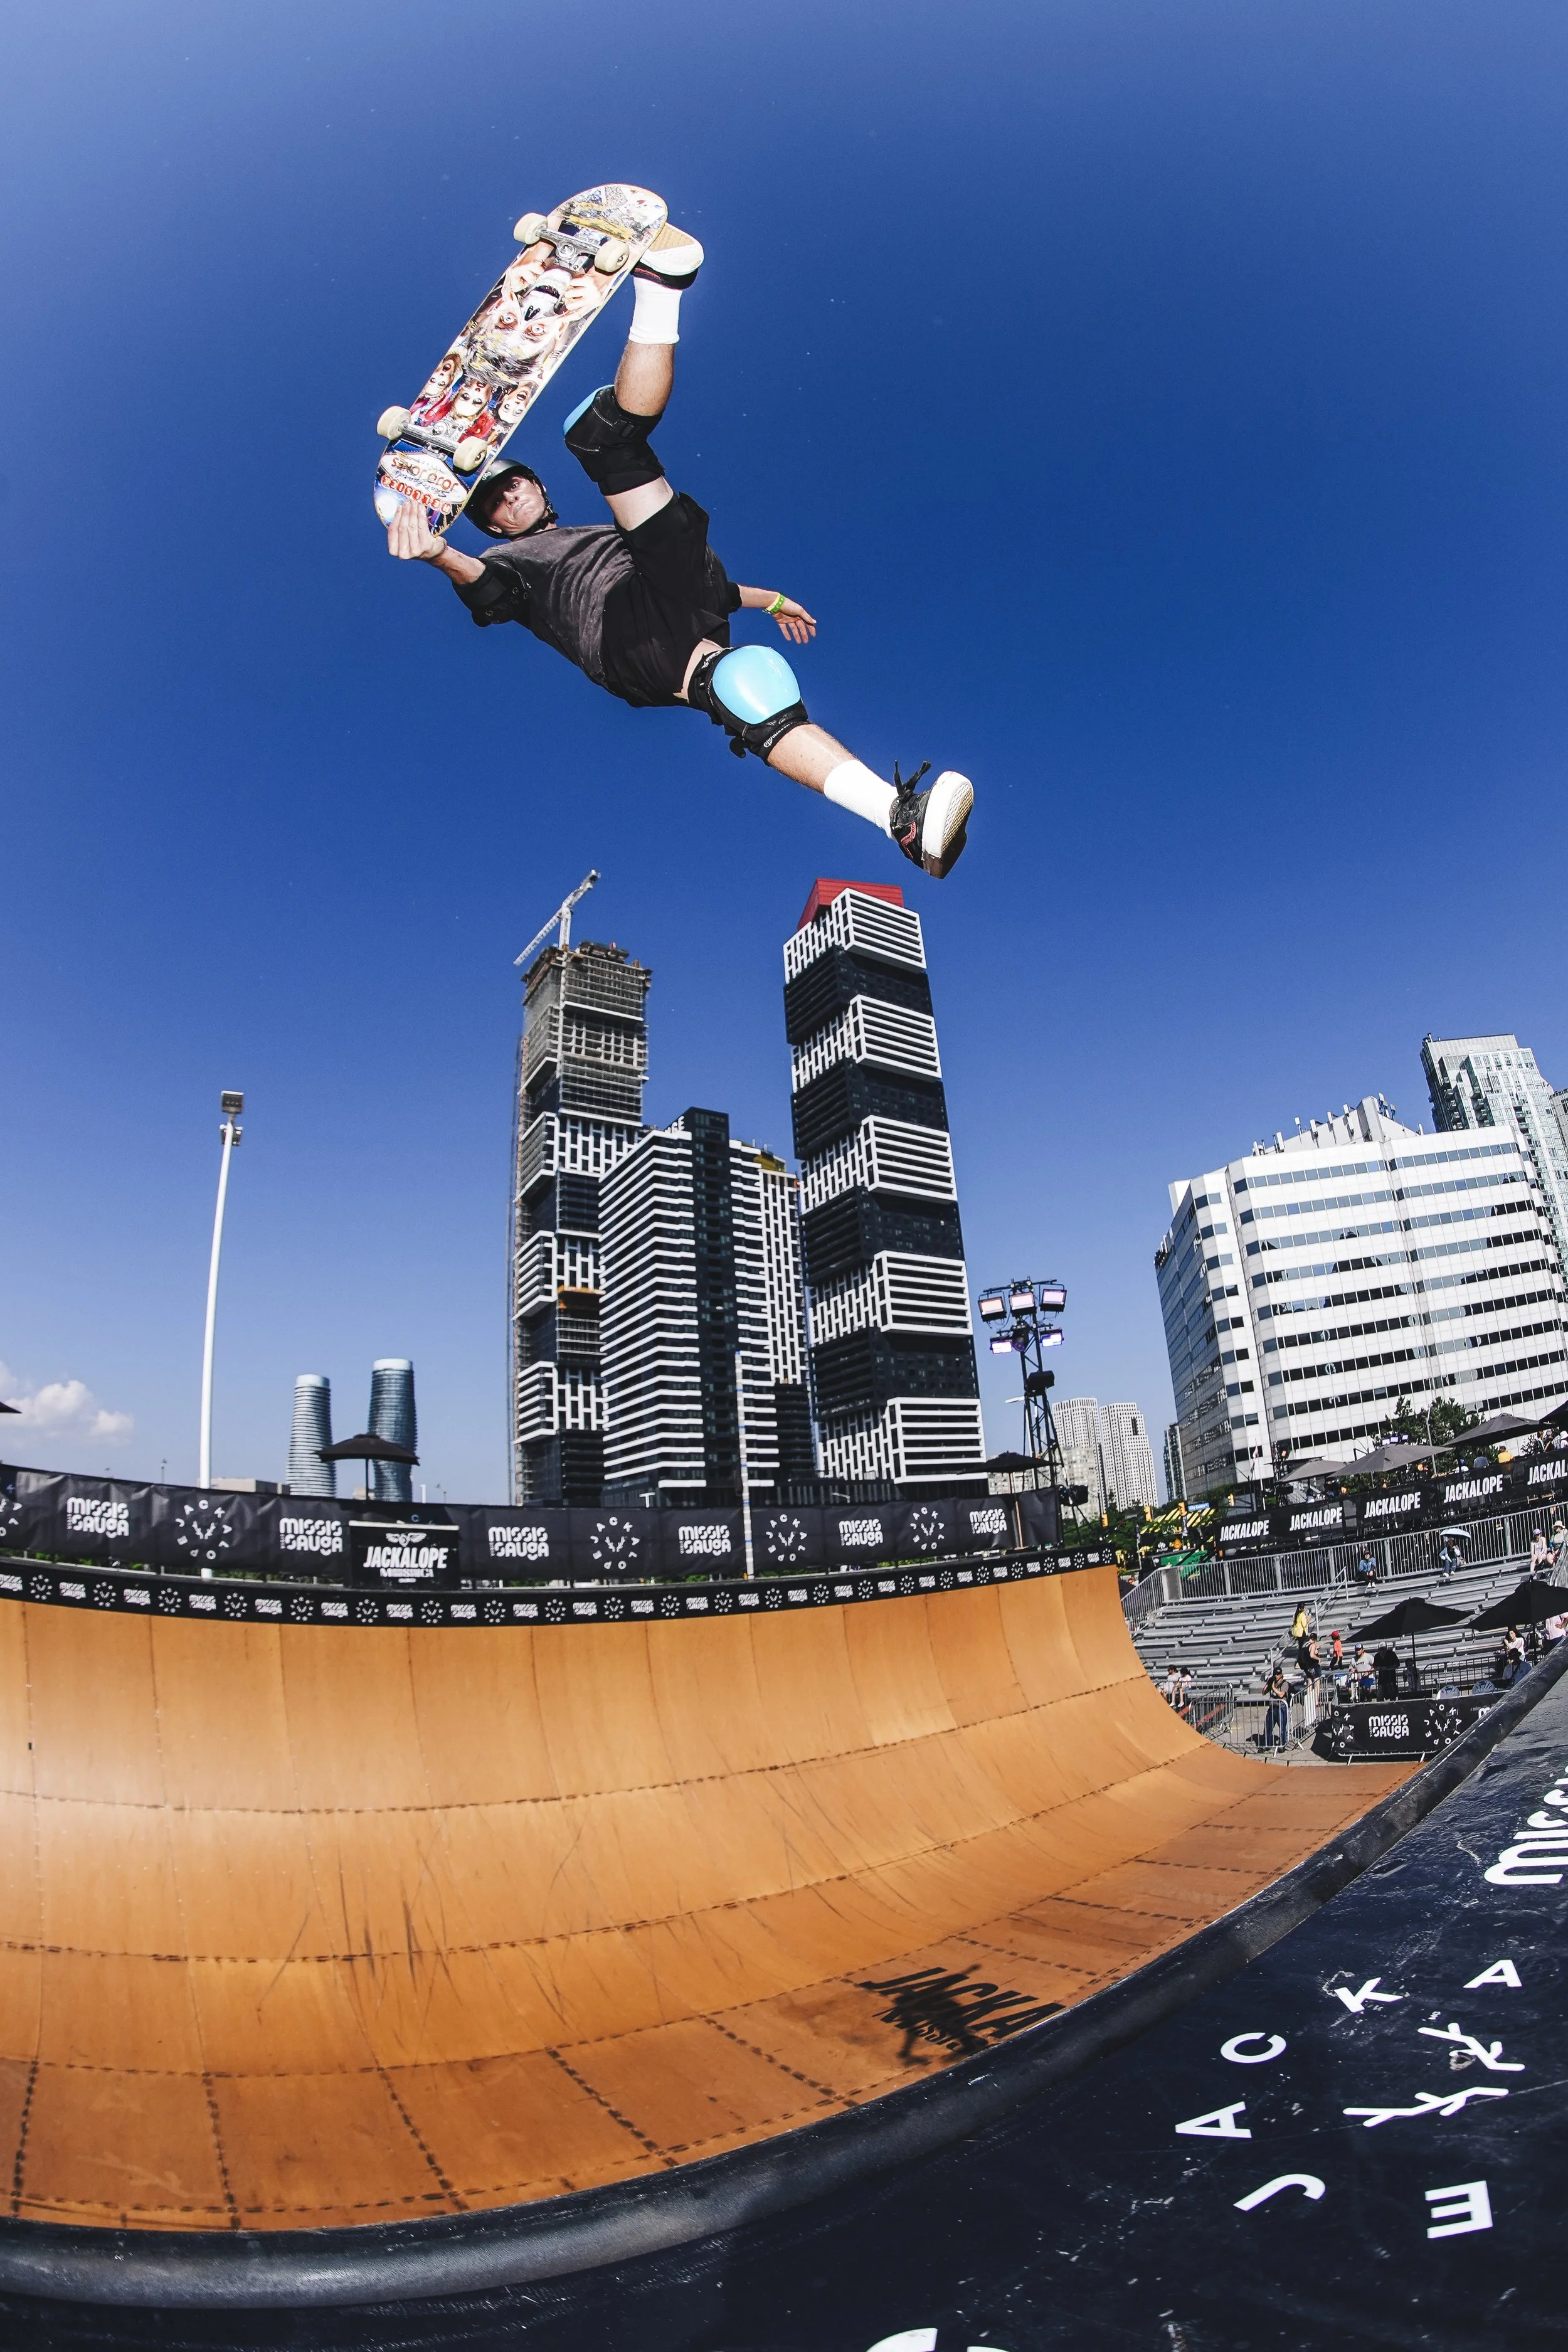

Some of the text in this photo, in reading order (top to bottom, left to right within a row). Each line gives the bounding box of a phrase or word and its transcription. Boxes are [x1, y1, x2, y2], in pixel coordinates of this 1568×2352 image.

[1527, 1459, 1568, 1485] JACKAL
[1443, 1474, 1503, 1503] JACKALOPE
[1364, 1491, 1421, 1518] JACKALOPE
[1219, 1520, 1269, 1542] JACKALOPE
[1290, 1507, 1343, 1531] JACKALOPE
[363, 1546, 449, 1569] JACKALOPE
[857, 1967, 1066, 2038] JACKA
